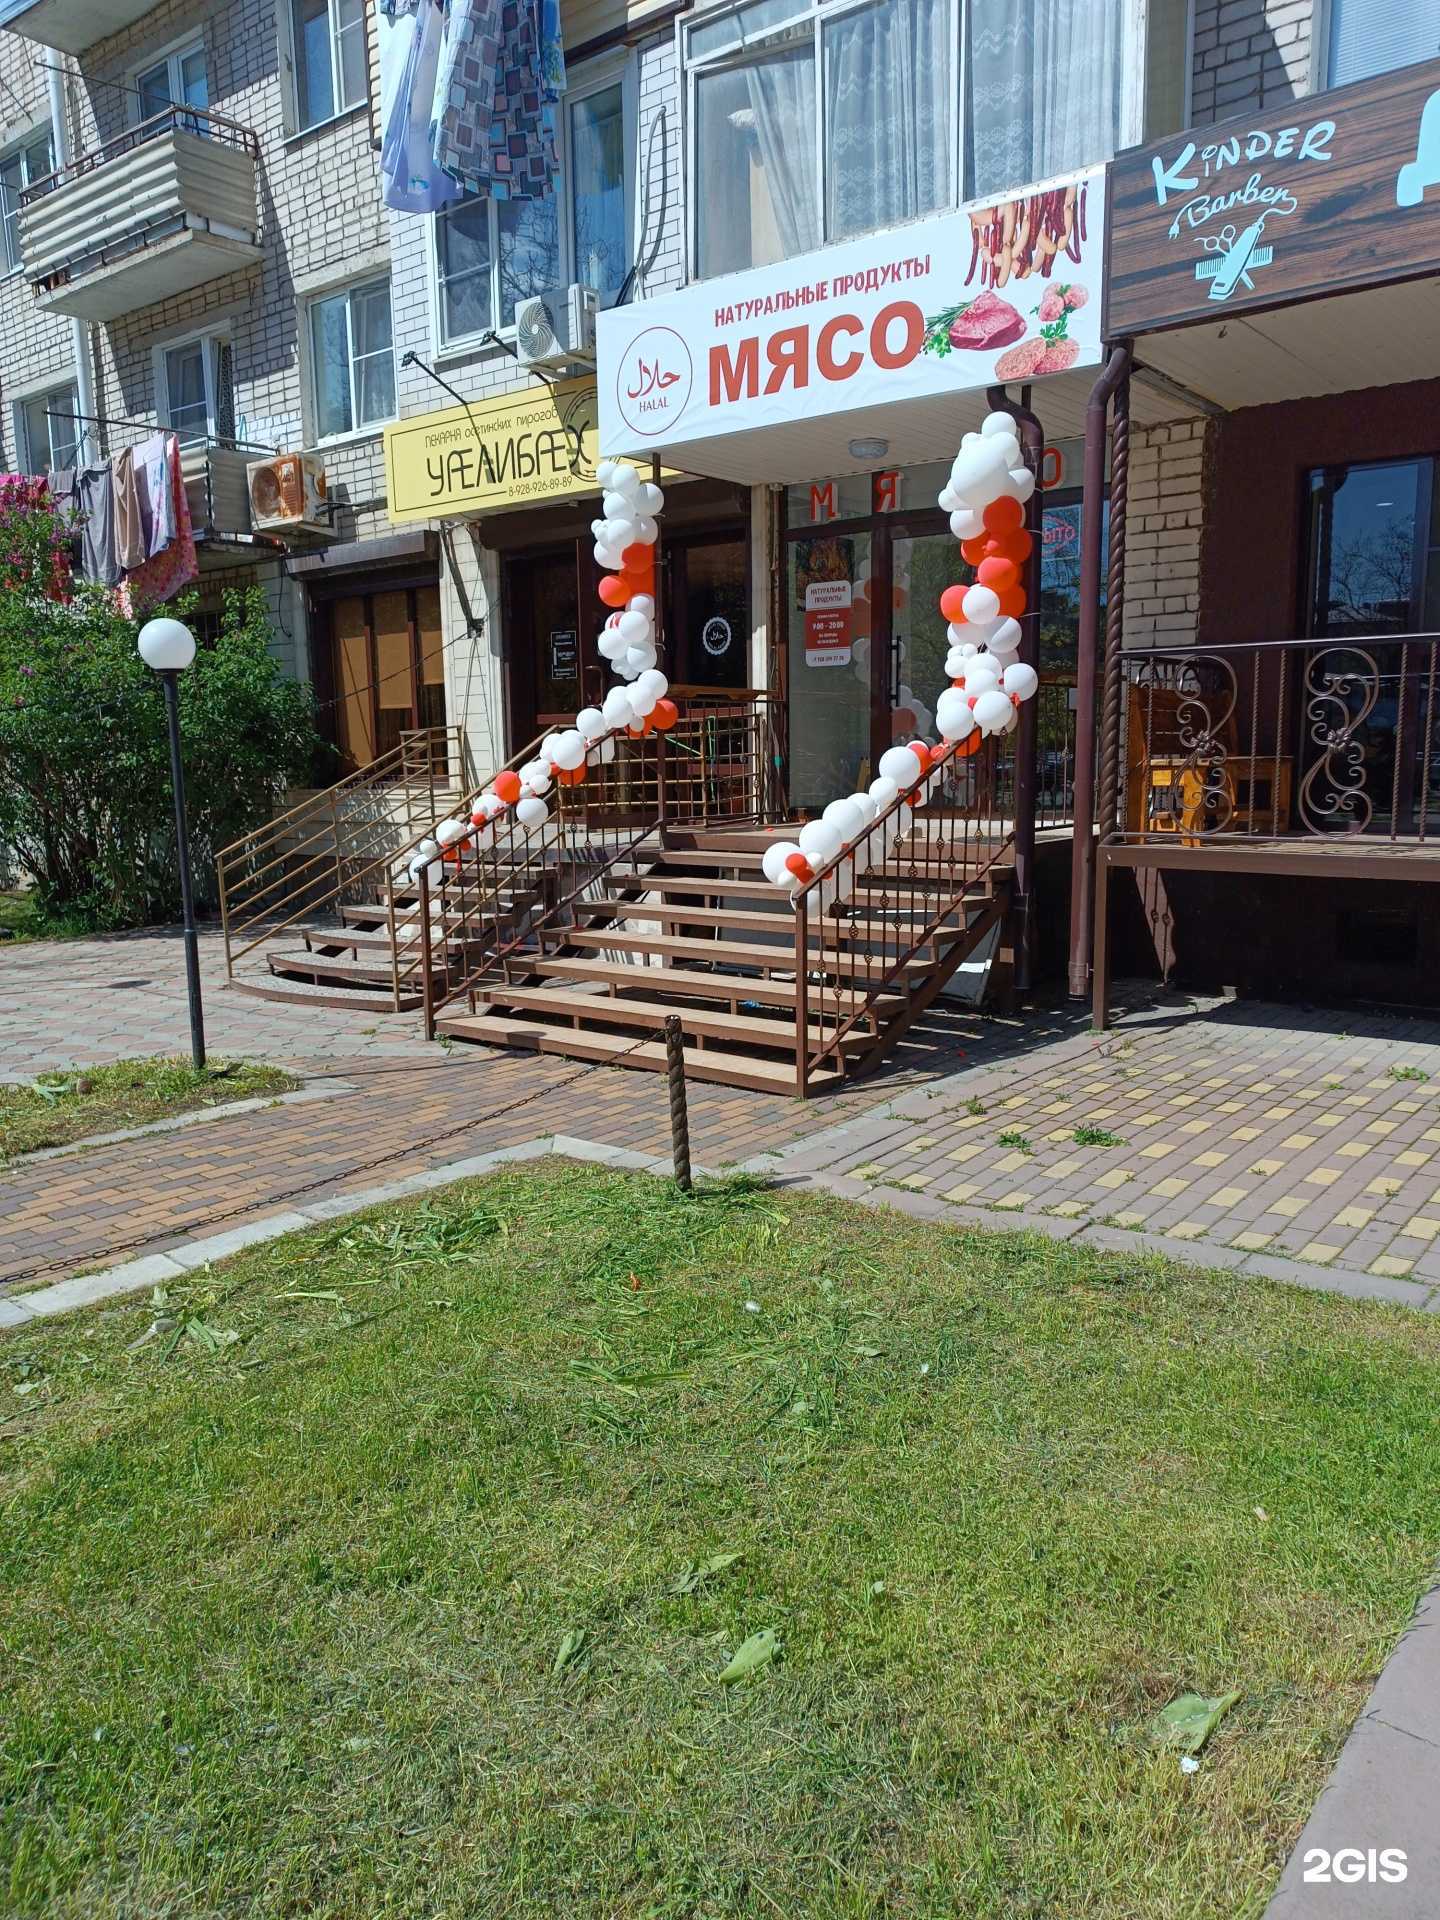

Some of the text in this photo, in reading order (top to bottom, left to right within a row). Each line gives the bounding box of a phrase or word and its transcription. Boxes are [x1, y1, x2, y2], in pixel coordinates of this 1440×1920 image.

[1186, 172, 1297, 229] Barber
[714, 254, 931, 328] НАТУРАЛЬНЫЕ ПРОДУКТЫ
[708, 300, 926, 407] МЯСО
[626, 358, 681, 400] حلال
[638, 398, 670, 414] HALAL
[508, 476, 573, 498] 8-928-926-89-89
